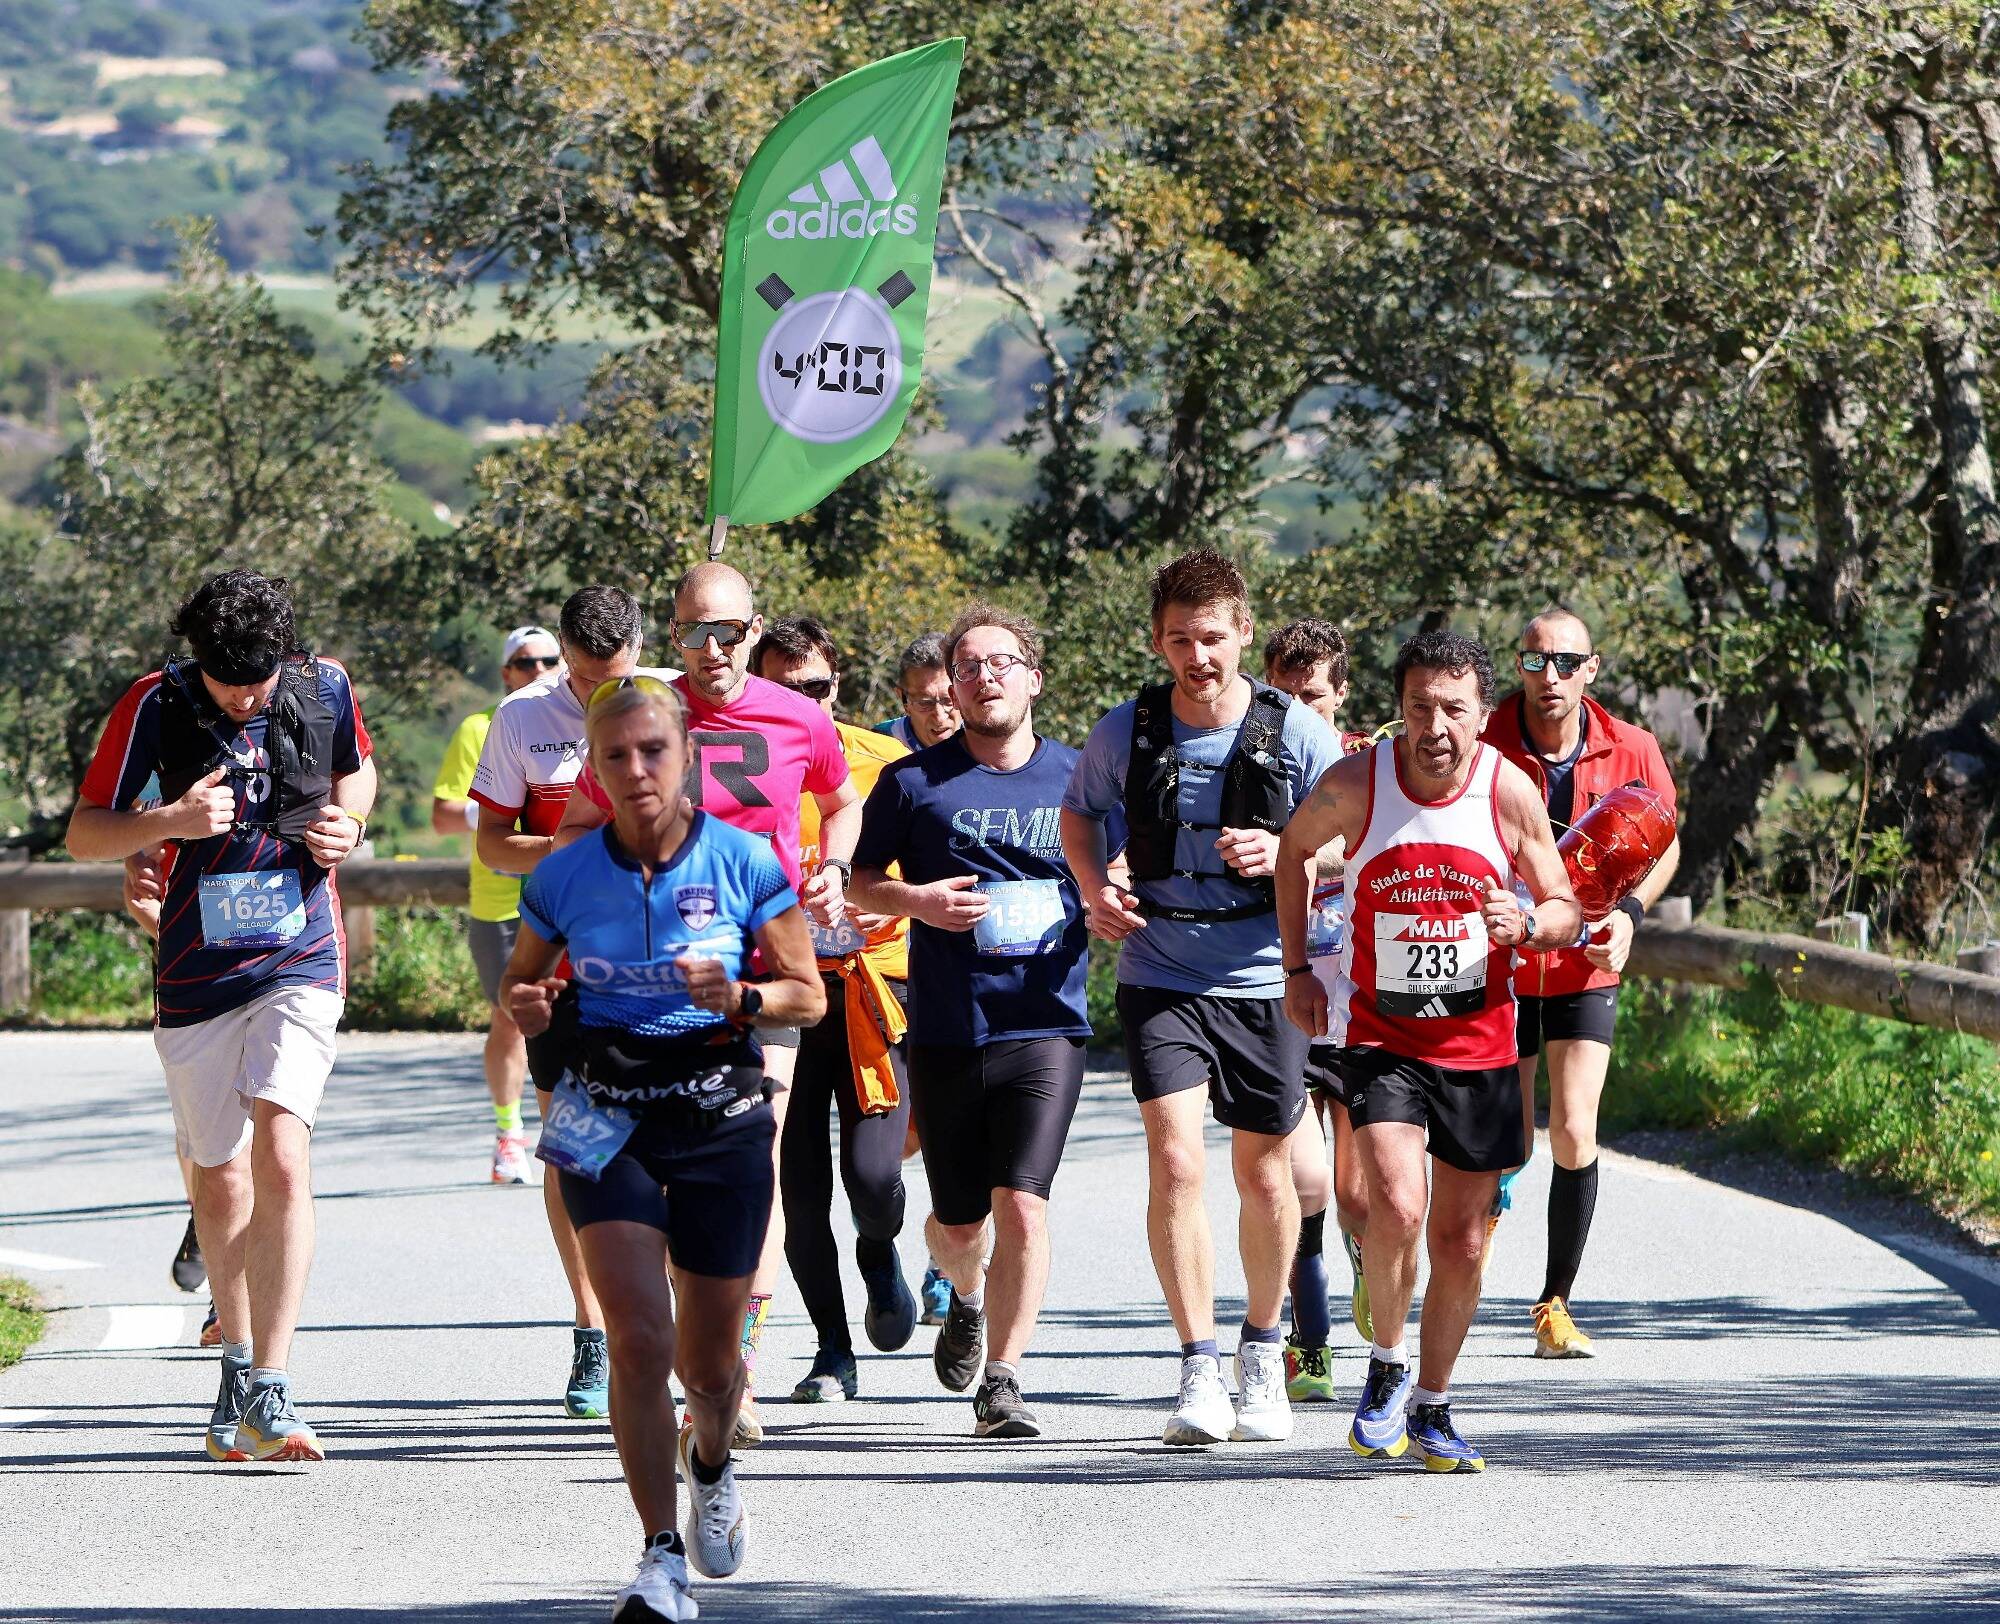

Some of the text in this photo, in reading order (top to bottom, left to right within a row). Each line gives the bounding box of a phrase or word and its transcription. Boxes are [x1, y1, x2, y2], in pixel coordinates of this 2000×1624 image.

[766, 200, 917, 240] adidas
[1370, 868, 1411, 894] Stade
[1414, 863, 1435, 879] de
[217, 893, 288, 920] 1625
[1389, 887, 1473, 903] Athlétisme
[236, 920, 272, 929] DELGADO
[1408, 919, 1467, 938] MAIF
[1406, 944, 1459, 979] 233
[1407, 983, 1458, 994] GILLES-KAMEL
[548, 1099, 615, 1145] 1647
